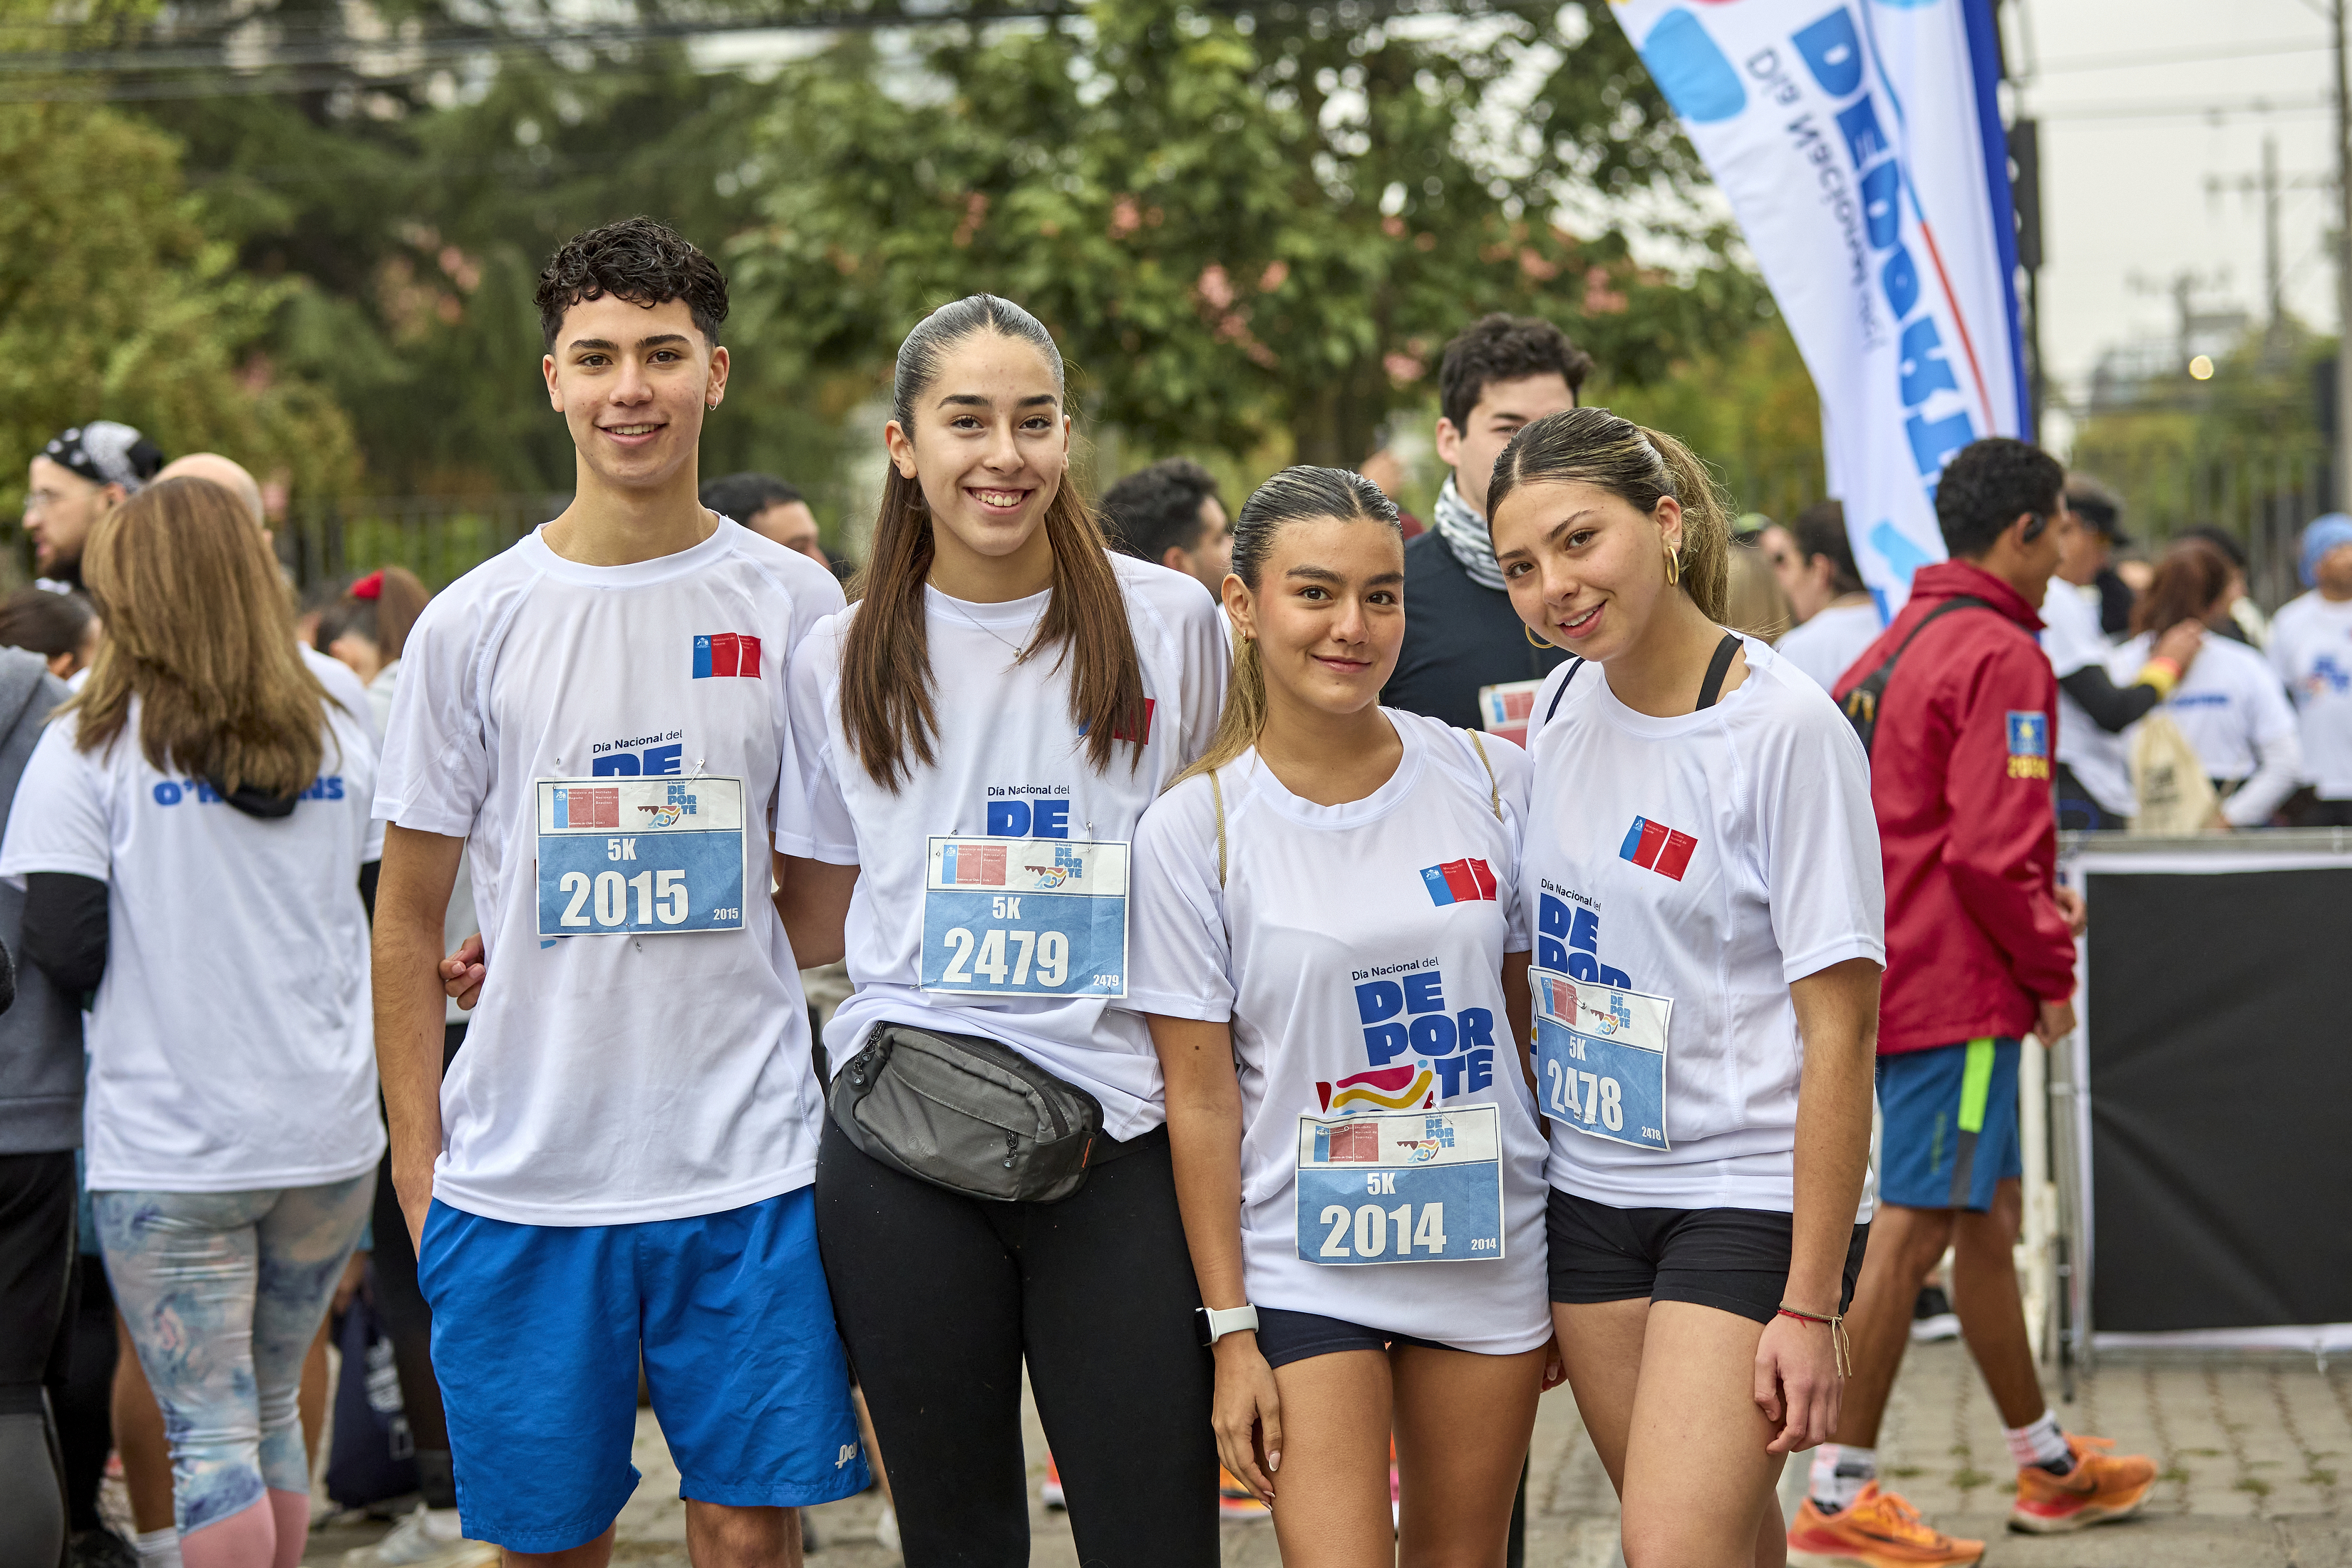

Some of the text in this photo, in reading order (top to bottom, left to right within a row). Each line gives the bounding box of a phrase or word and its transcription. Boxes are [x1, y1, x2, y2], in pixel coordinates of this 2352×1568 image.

[593, 729, 683, 753] Día Nacional del
[592, 743, 682, 777] DE
[667, 785, 685, 795] DE
[988, 785, 1070, 796] Día Nacional del
[667, 795, 697, 805] POR
[681, 805, 697, 815] TE
[987, 799, 1070, 839] DE
[608, 838, 637, 861] 5K
[1055, 847, 1072, 857] DE
[1055, 857, 1083, 868] POR
[1068, 868, 1083, 878] TE
[559, 870, 688, 927] 2015
[1541, 878, 1554, 891] Día
[1556, 884, 1592, 907] Nacional
[713, 907, 738, 921] 2015
[992, 897, 1021, 919] 5K
[1539, 892, 1599, 956] DE
[942, 927, 1069, 987] 2479
[1352, 956, 1439, 981] Día Nacional del
[1093, 975, 1119, 987] 2479
[1355, 971, 1445, 1025] DE
[1611, 995, 1624, 1006] DE
[1610, 1005, 1631, 1019] POR
[1619, 1017, 1630, 1028] TE
[1363, 1007, 1495, 1067] POR
[1569, 1035, 1586, 1061] 5K
[1433, 1048, 1493, 1099] TE
[1547, 1059, 1623, 1132] 2478
[1425, 1118, 1443, 1129] DE
[1641, 1125, 1661, 1140] 2478
[1425, 1127, 1454, 1139] POR
[1440, 1138, 1455, 1148] TE
[1367, 1172, 1396, 1195] 5K
[1319, 1202, 1447, 1257] 2014
[1471, 1238, 1497, 1250] 2014
